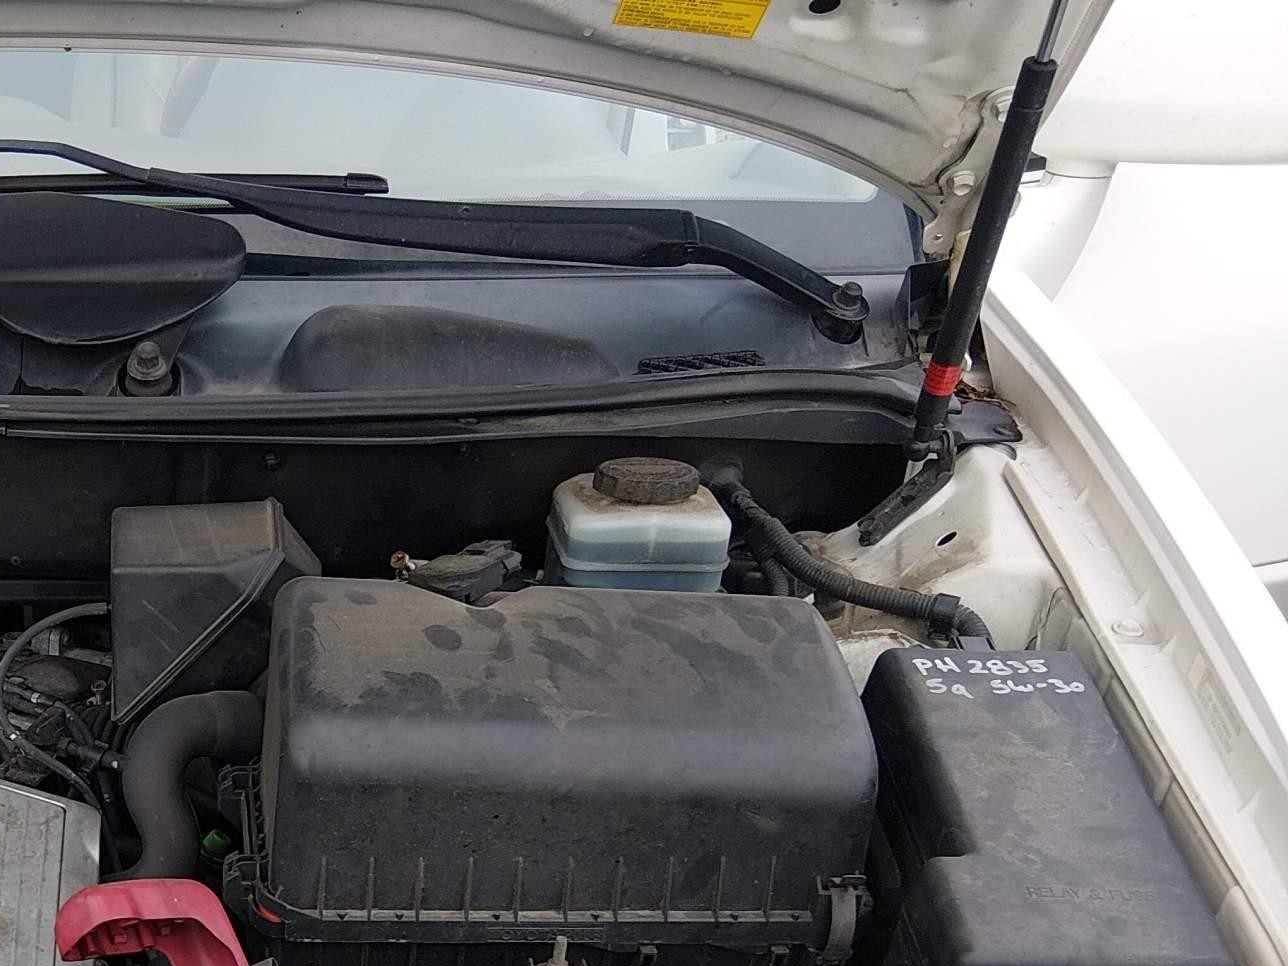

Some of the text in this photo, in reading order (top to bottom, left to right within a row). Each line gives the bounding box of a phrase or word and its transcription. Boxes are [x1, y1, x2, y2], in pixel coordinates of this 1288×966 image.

[912, 657, 1049, 676] PH 2835
[1025, 885, 1081, 899] RELAY
[1089, 888, 1104, 900] &
